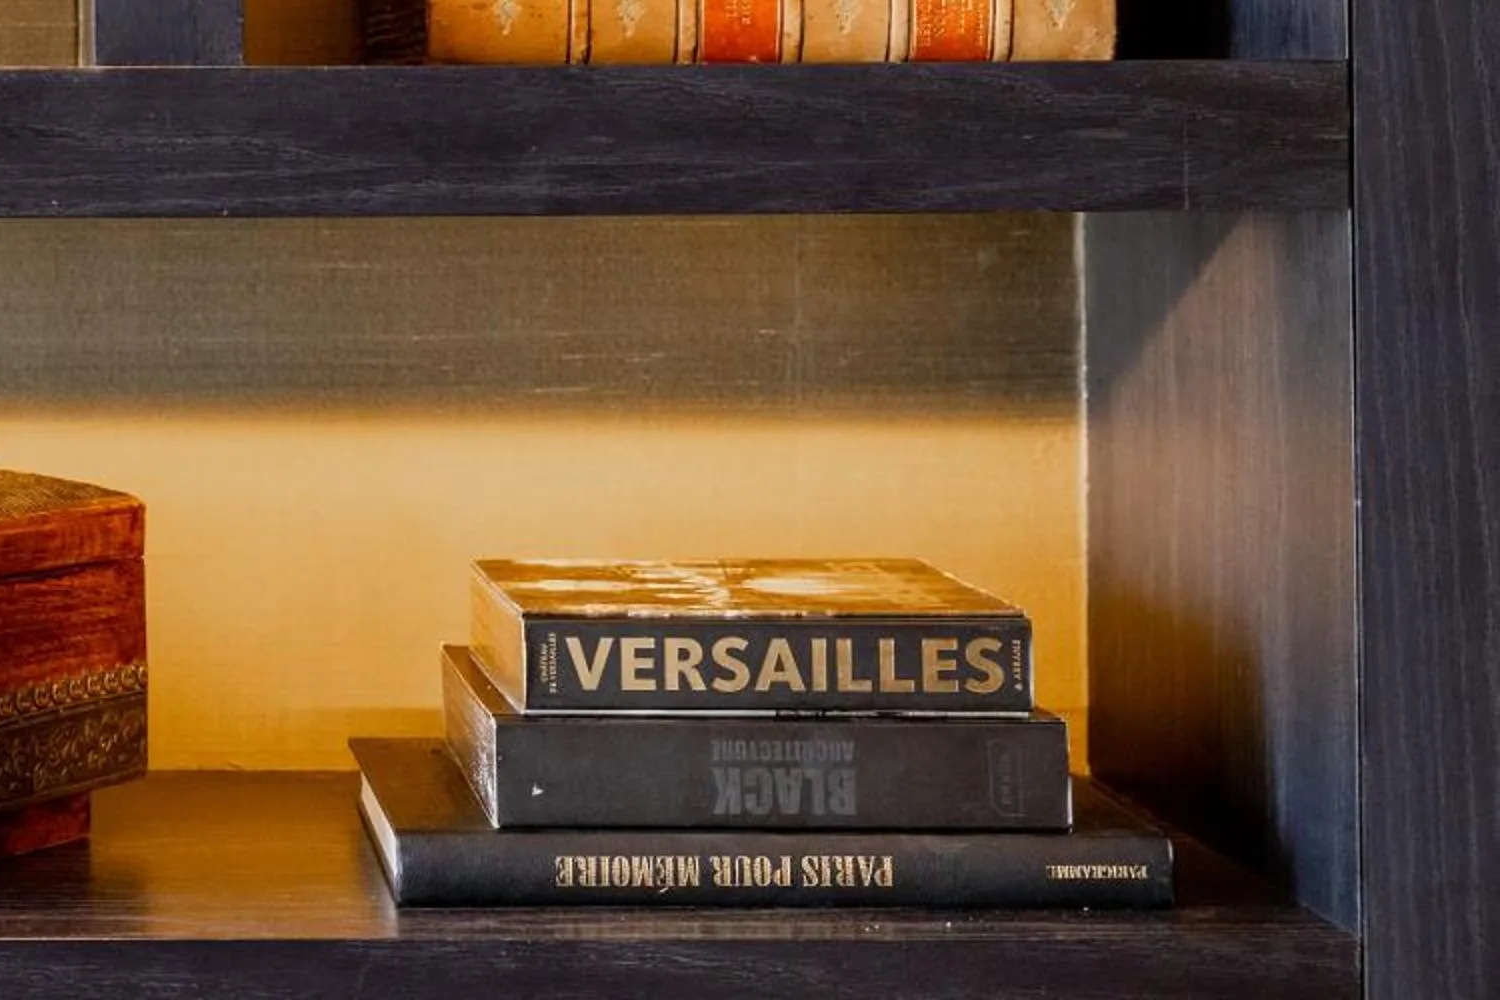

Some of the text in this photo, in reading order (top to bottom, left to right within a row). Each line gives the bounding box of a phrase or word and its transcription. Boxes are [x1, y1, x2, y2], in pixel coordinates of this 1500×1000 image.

[565, 637, 1005, 693] VERSAILLES
[711, 740, 855, 762] ARCHITECTURE
[711, 767, 856, 815] BLACK
[554, 855, 894, 893] PARIS POUR MÉMOIRE
[1045, 865, 1148, 879] PARIGRAMME
